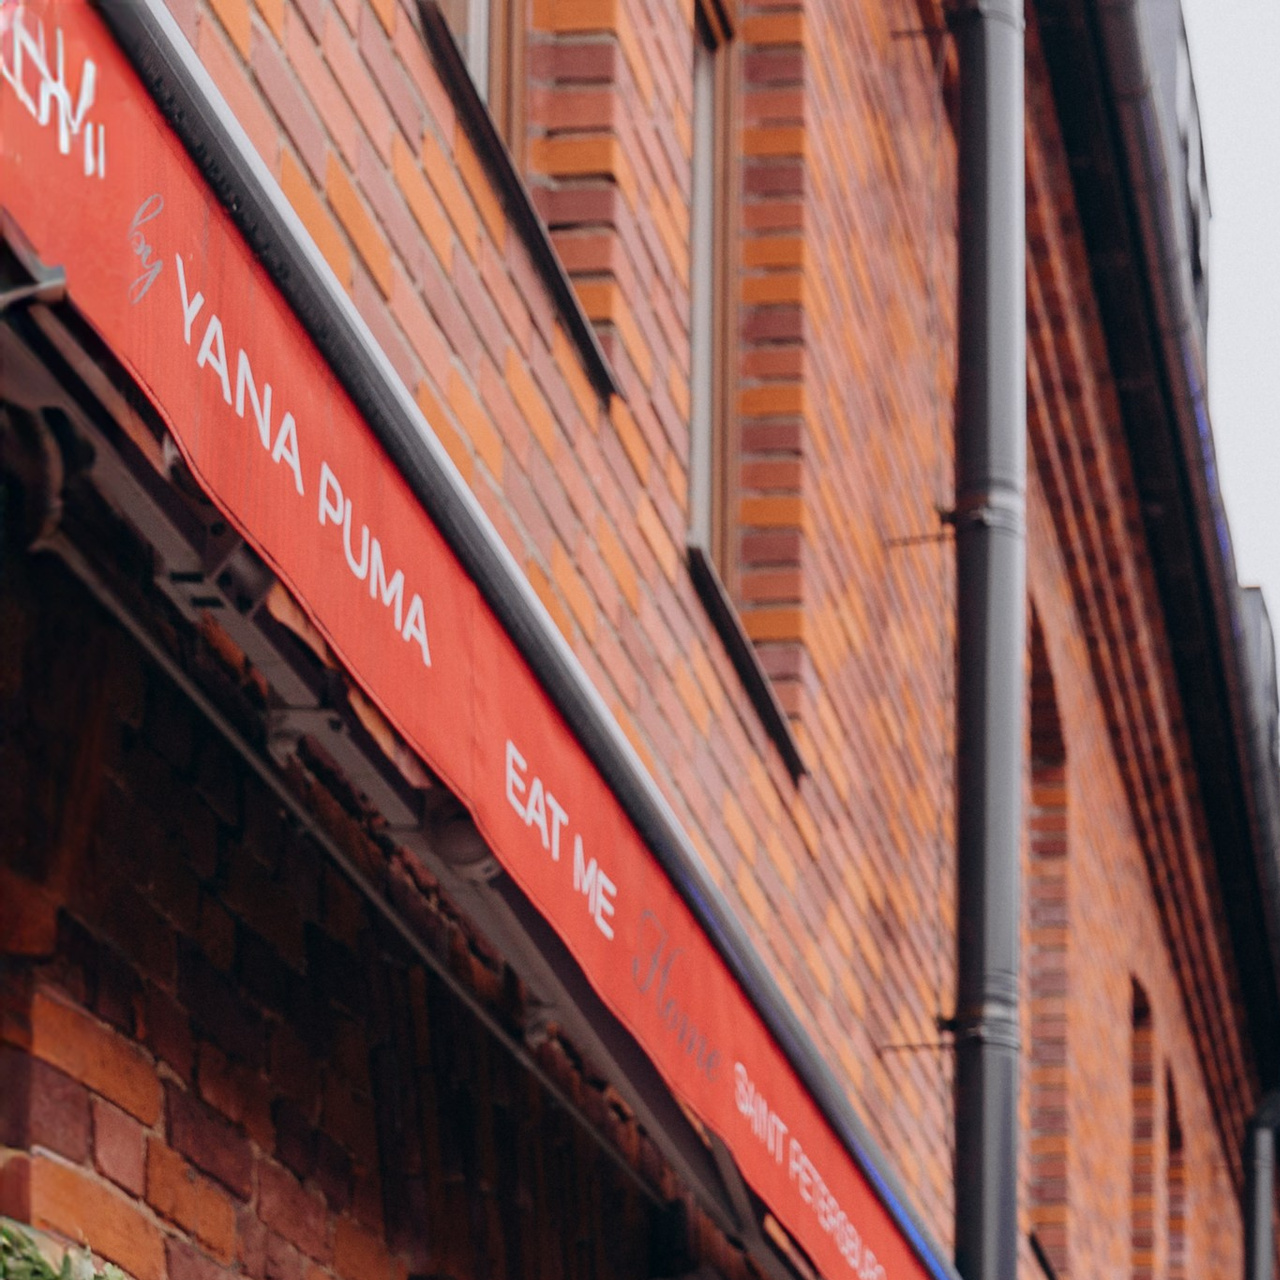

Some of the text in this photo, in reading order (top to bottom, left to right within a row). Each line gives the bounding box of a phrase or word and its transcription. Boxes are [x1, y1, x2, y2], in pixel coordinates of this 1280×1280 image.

[128, 193, 432, 668] by YANA PUMA
[505, 739, 619, 942] EAT ME
[735, 1061, 789, 1165] SAINT
